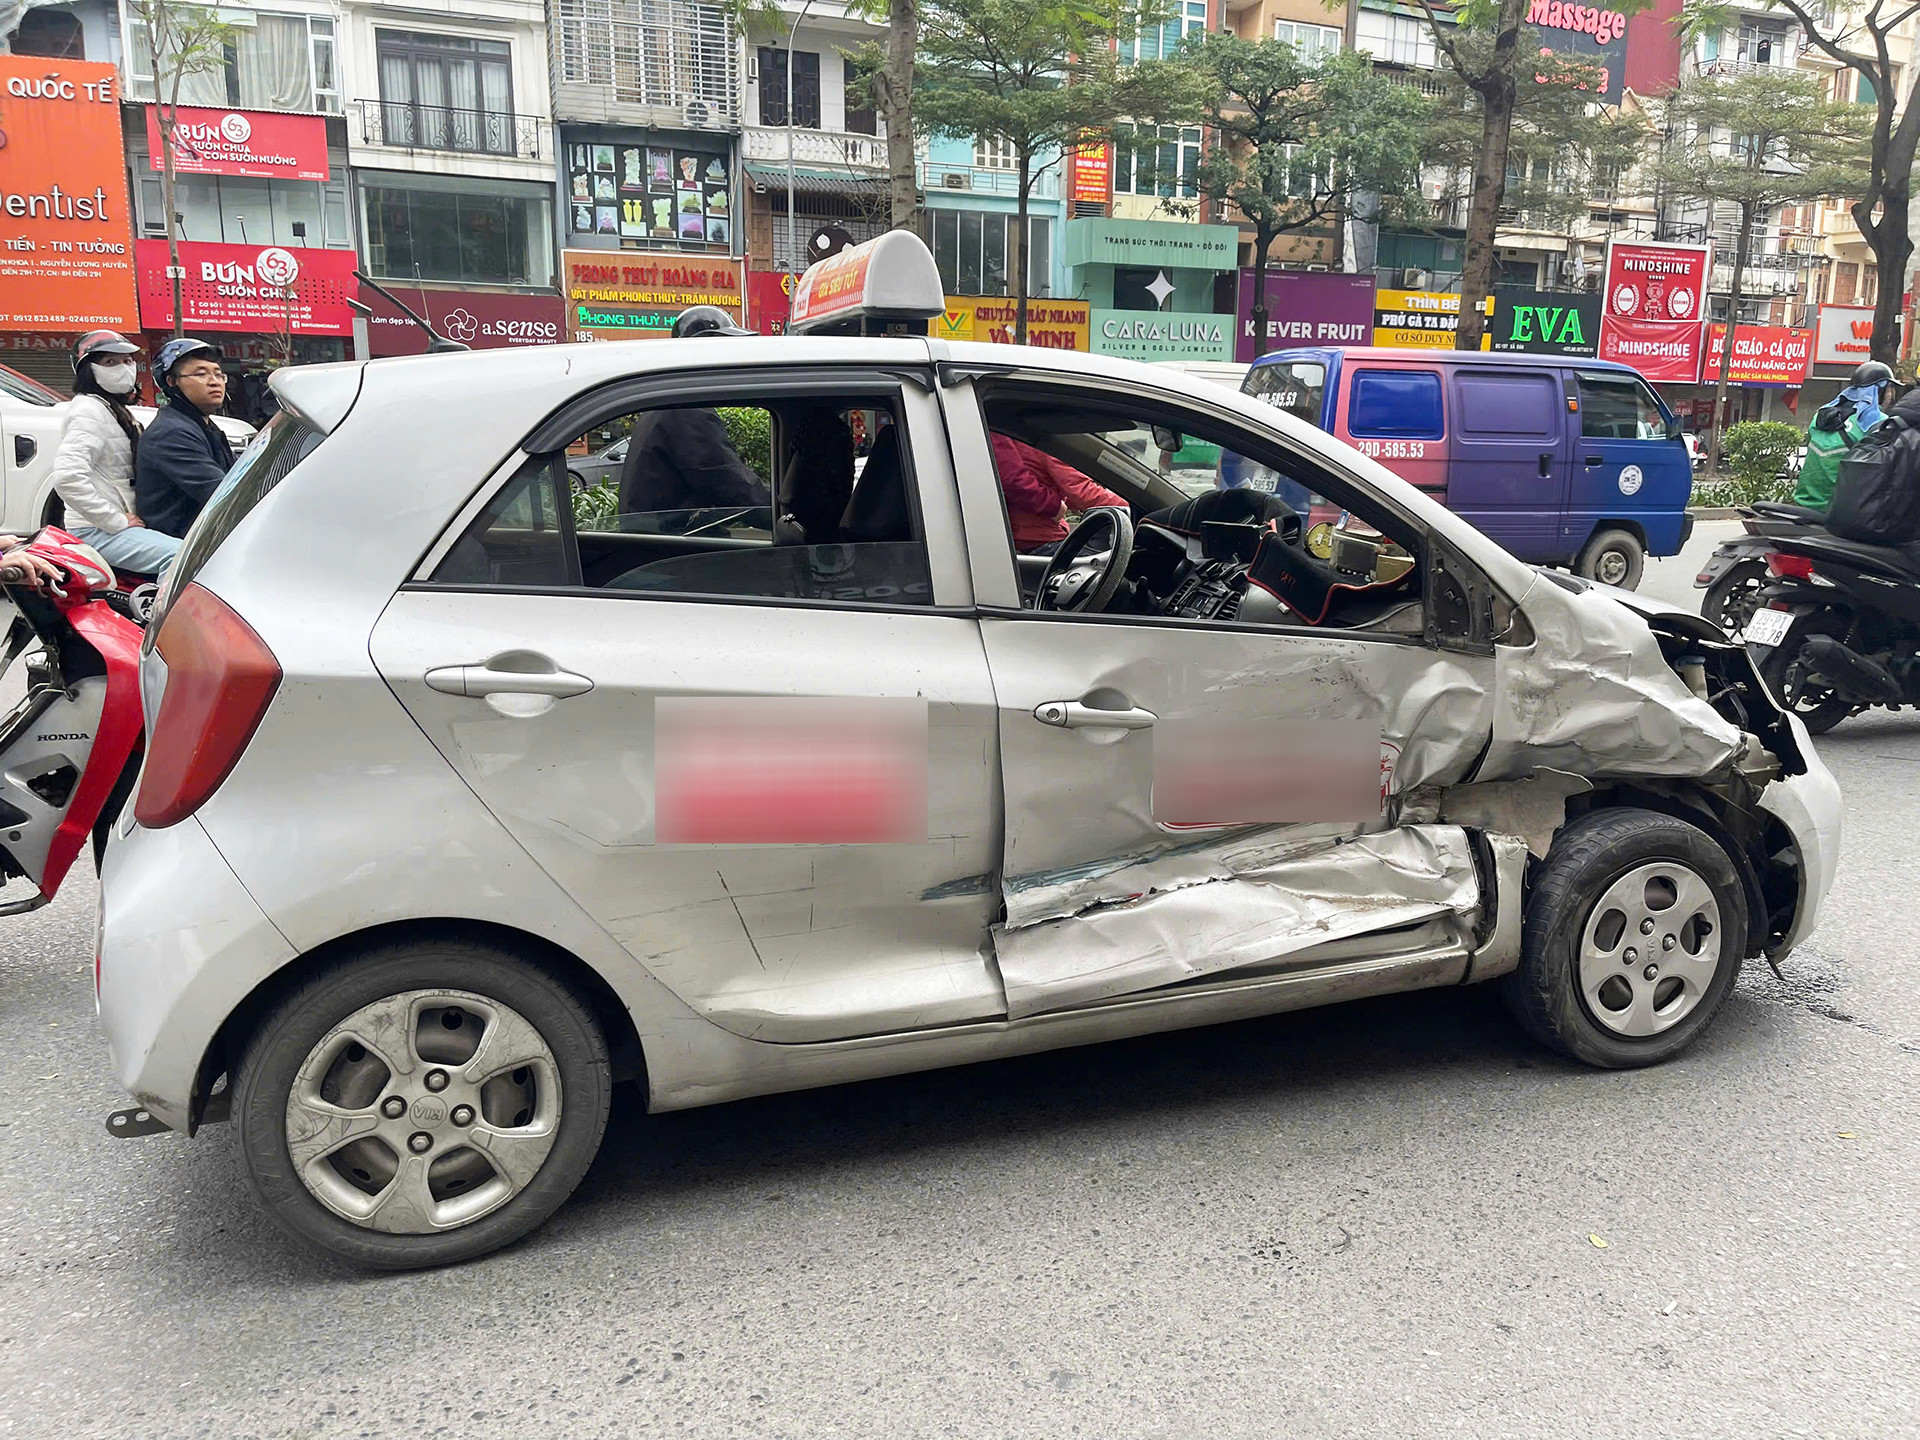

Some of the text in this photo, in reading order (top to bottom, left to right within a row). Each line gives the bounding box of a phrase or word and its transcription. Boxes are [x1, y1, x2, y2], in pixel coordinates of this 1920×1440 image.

[1525, 0, 1626, 45] Massage
[7, 72, 114, 103] QUỐC TẾ
[179, 122, 220, 142] BÚN
[227, 118, 244, 137] 63
[0, 184, 108, 222] entist
[5, 235, 35, 251] TIẾN
[50, 241, 73, 253] TIN
[76, 238, 125, 254] TƯỞNG
[1104, 236, 1129, 245] TRANG
[1169, 240, 1193, 249] TRANG
[201, 260, 255, 284] BÚN
[266, 252, 288, 277] 63
[1623, 259, 1690, 275] MINDSHINE
[572, 264, 618, 284] PHONG
[663, 266, 708, 288] HOÀNG
[712, 270, 736, 289] GIA
[619, 291, 652, 303] PHONG
[1405, 294, 1439, 310] THÌN
[388, 317, 402, 326] đẹp
[579, 312, 625, 326] PHONG
[1027, 305, 1047, 323] HÁT
[1049, 309, 1086, 324] NHANH
[1381, 311, 1407, 327] PHỞ
[1407, 313, 1423, 328] GÀ
[1423, 316, 1438, 328] TA
[482, 319, 557, 337] a.sense
[1168, 322, 1223, 342] LUNA
[1245, 319, 1365, 341] KEVER FRUIT
[1509, 305, 1586, 344] EVA
[575, 331, 593, 342] 185
[1029, 329, 1076, 349] MINH
[1425, 333, 1445, 343] DUY
[1102, 343, 1136, 351] SILVER
[1181, 345, 1223, 353] JEWELRY
[1618, 341, 1690, 357] MINDSHINE
[1735, 336, 1763, 355] CHÁO
[1769, 338, 1783, 357] CÁ
[1784, 338, 1806, 360] QUẢ
[1741, 357, 1760, 369] NẤU
[1787, 362, 1804, 371] CAY
[1358, 441, 1424, 458] 29D-585.53
[37, 733, 90, 742] HONDA
